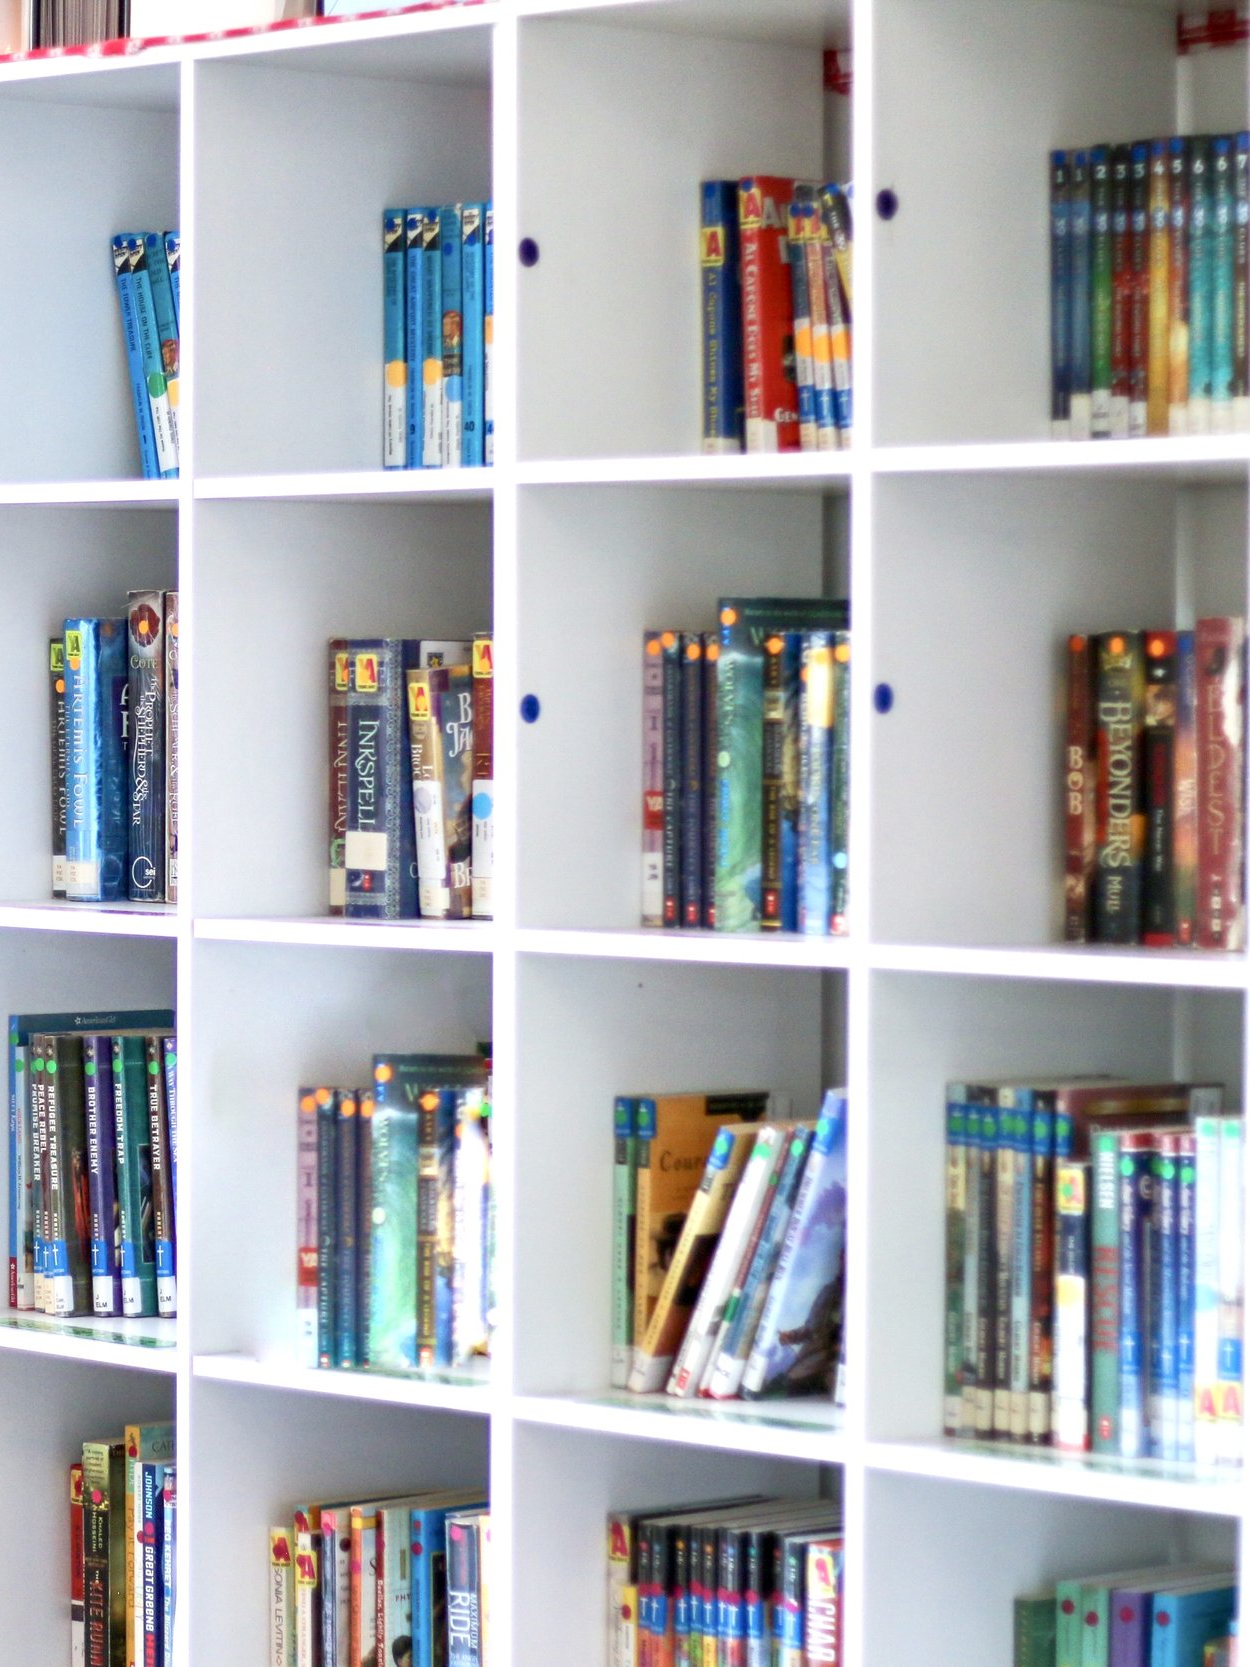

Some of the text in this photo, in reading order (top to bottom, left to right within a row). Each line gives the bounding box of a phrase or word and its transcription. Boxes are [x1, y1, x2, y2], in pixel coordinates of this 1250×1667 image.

[1152, 159, 1164, 175] 4
[1193, 159, 1205, 174] 6
[1217, 156, 1228, 172] 6
[354, 719, 380, 834] INKSPELL
[1098, 701, 1133, 868] BEYONDERS
[38, 1084, 48, 1154] PEACE REBEL
[48, 1085, 59, 1192] REFUGEE TREASURE
[88, 1086, 99, 1175] BROTHER ENEMY
[114, 1083, 125, 1165] FREEDOM TRAP
[150, 1084, 161, 1170] TRUE BETRAYER
[33, 1131, 41, 1181] BREAKER
[1098, 1151, 1116, 1209] NIELSEN
[1093, 1245, 1119, 1352] RESCUE
[145, 1471, 153, 1519] JOHNSON
[164, 1544, 172, 1587] KEHRET
[90, 1581, 104, 1618] KITE
[449, 1591, 471, 1648] RIDE
[470, 1593, 479, 1649] MAXIMUM
[274, 1608, 284, 1654] LEVITIN
